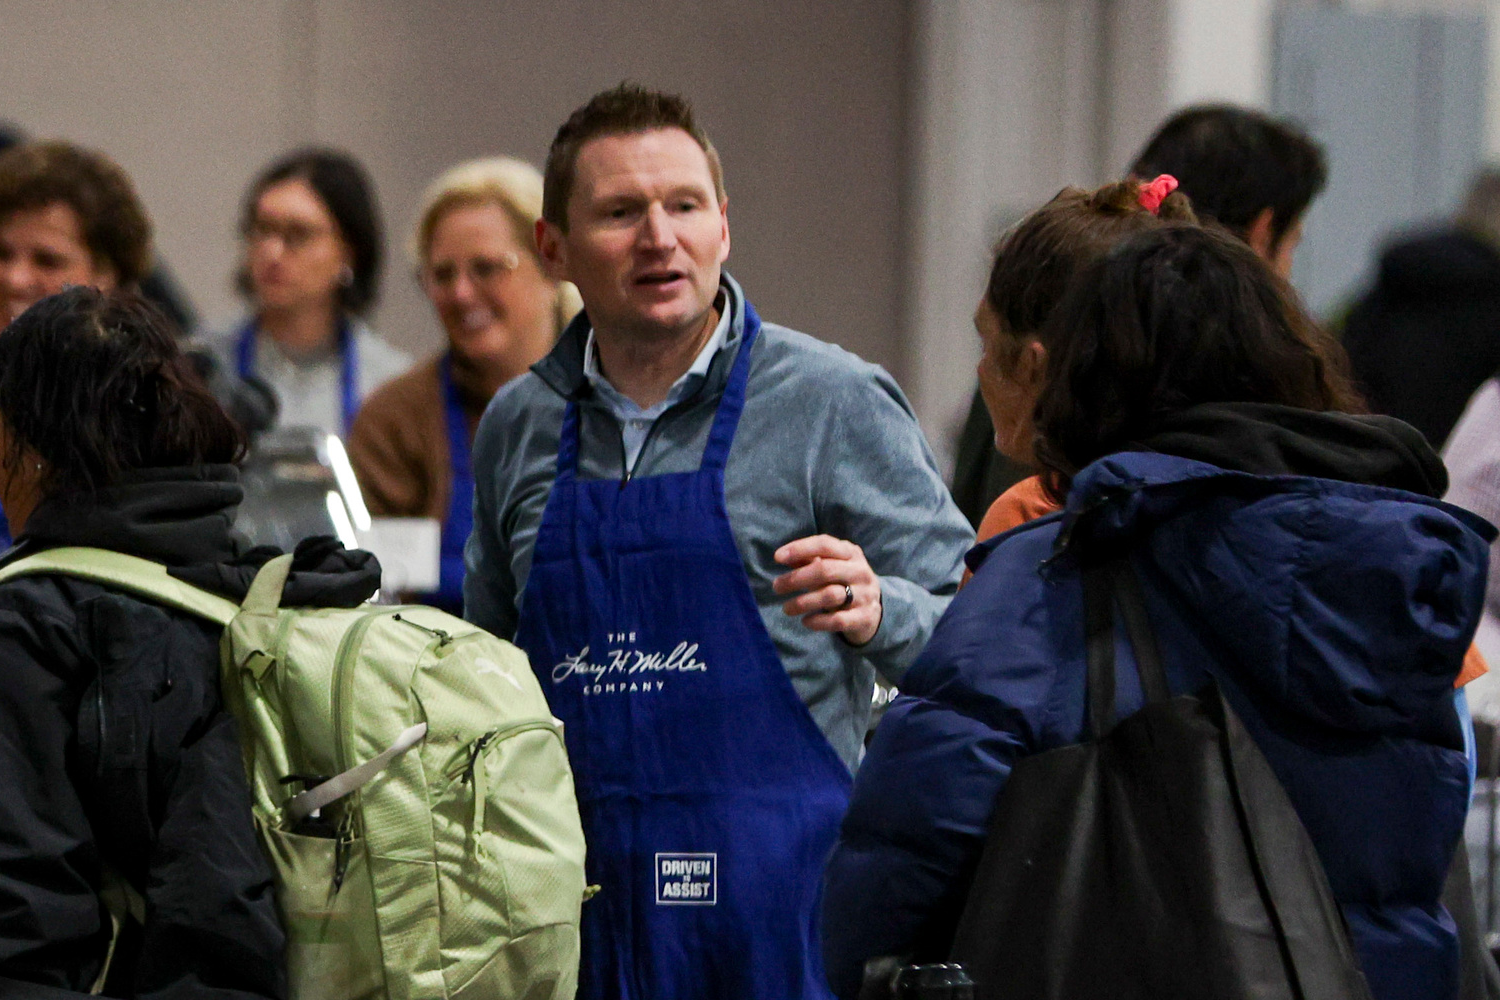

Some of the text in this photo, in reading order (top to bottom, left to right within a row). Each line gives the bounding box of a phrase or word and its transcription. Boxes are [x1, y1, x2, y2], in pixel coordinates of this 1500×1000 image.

[607, 631, 637, 644] THE
[551, 645, 607, 684] Larry
[628, 640, 708, 675] Miller
[583, 681, 665, 696] COMPANY
[661, 860, 711, 876] DRIVEN
[662, 882, 711, 898] ASSIST
